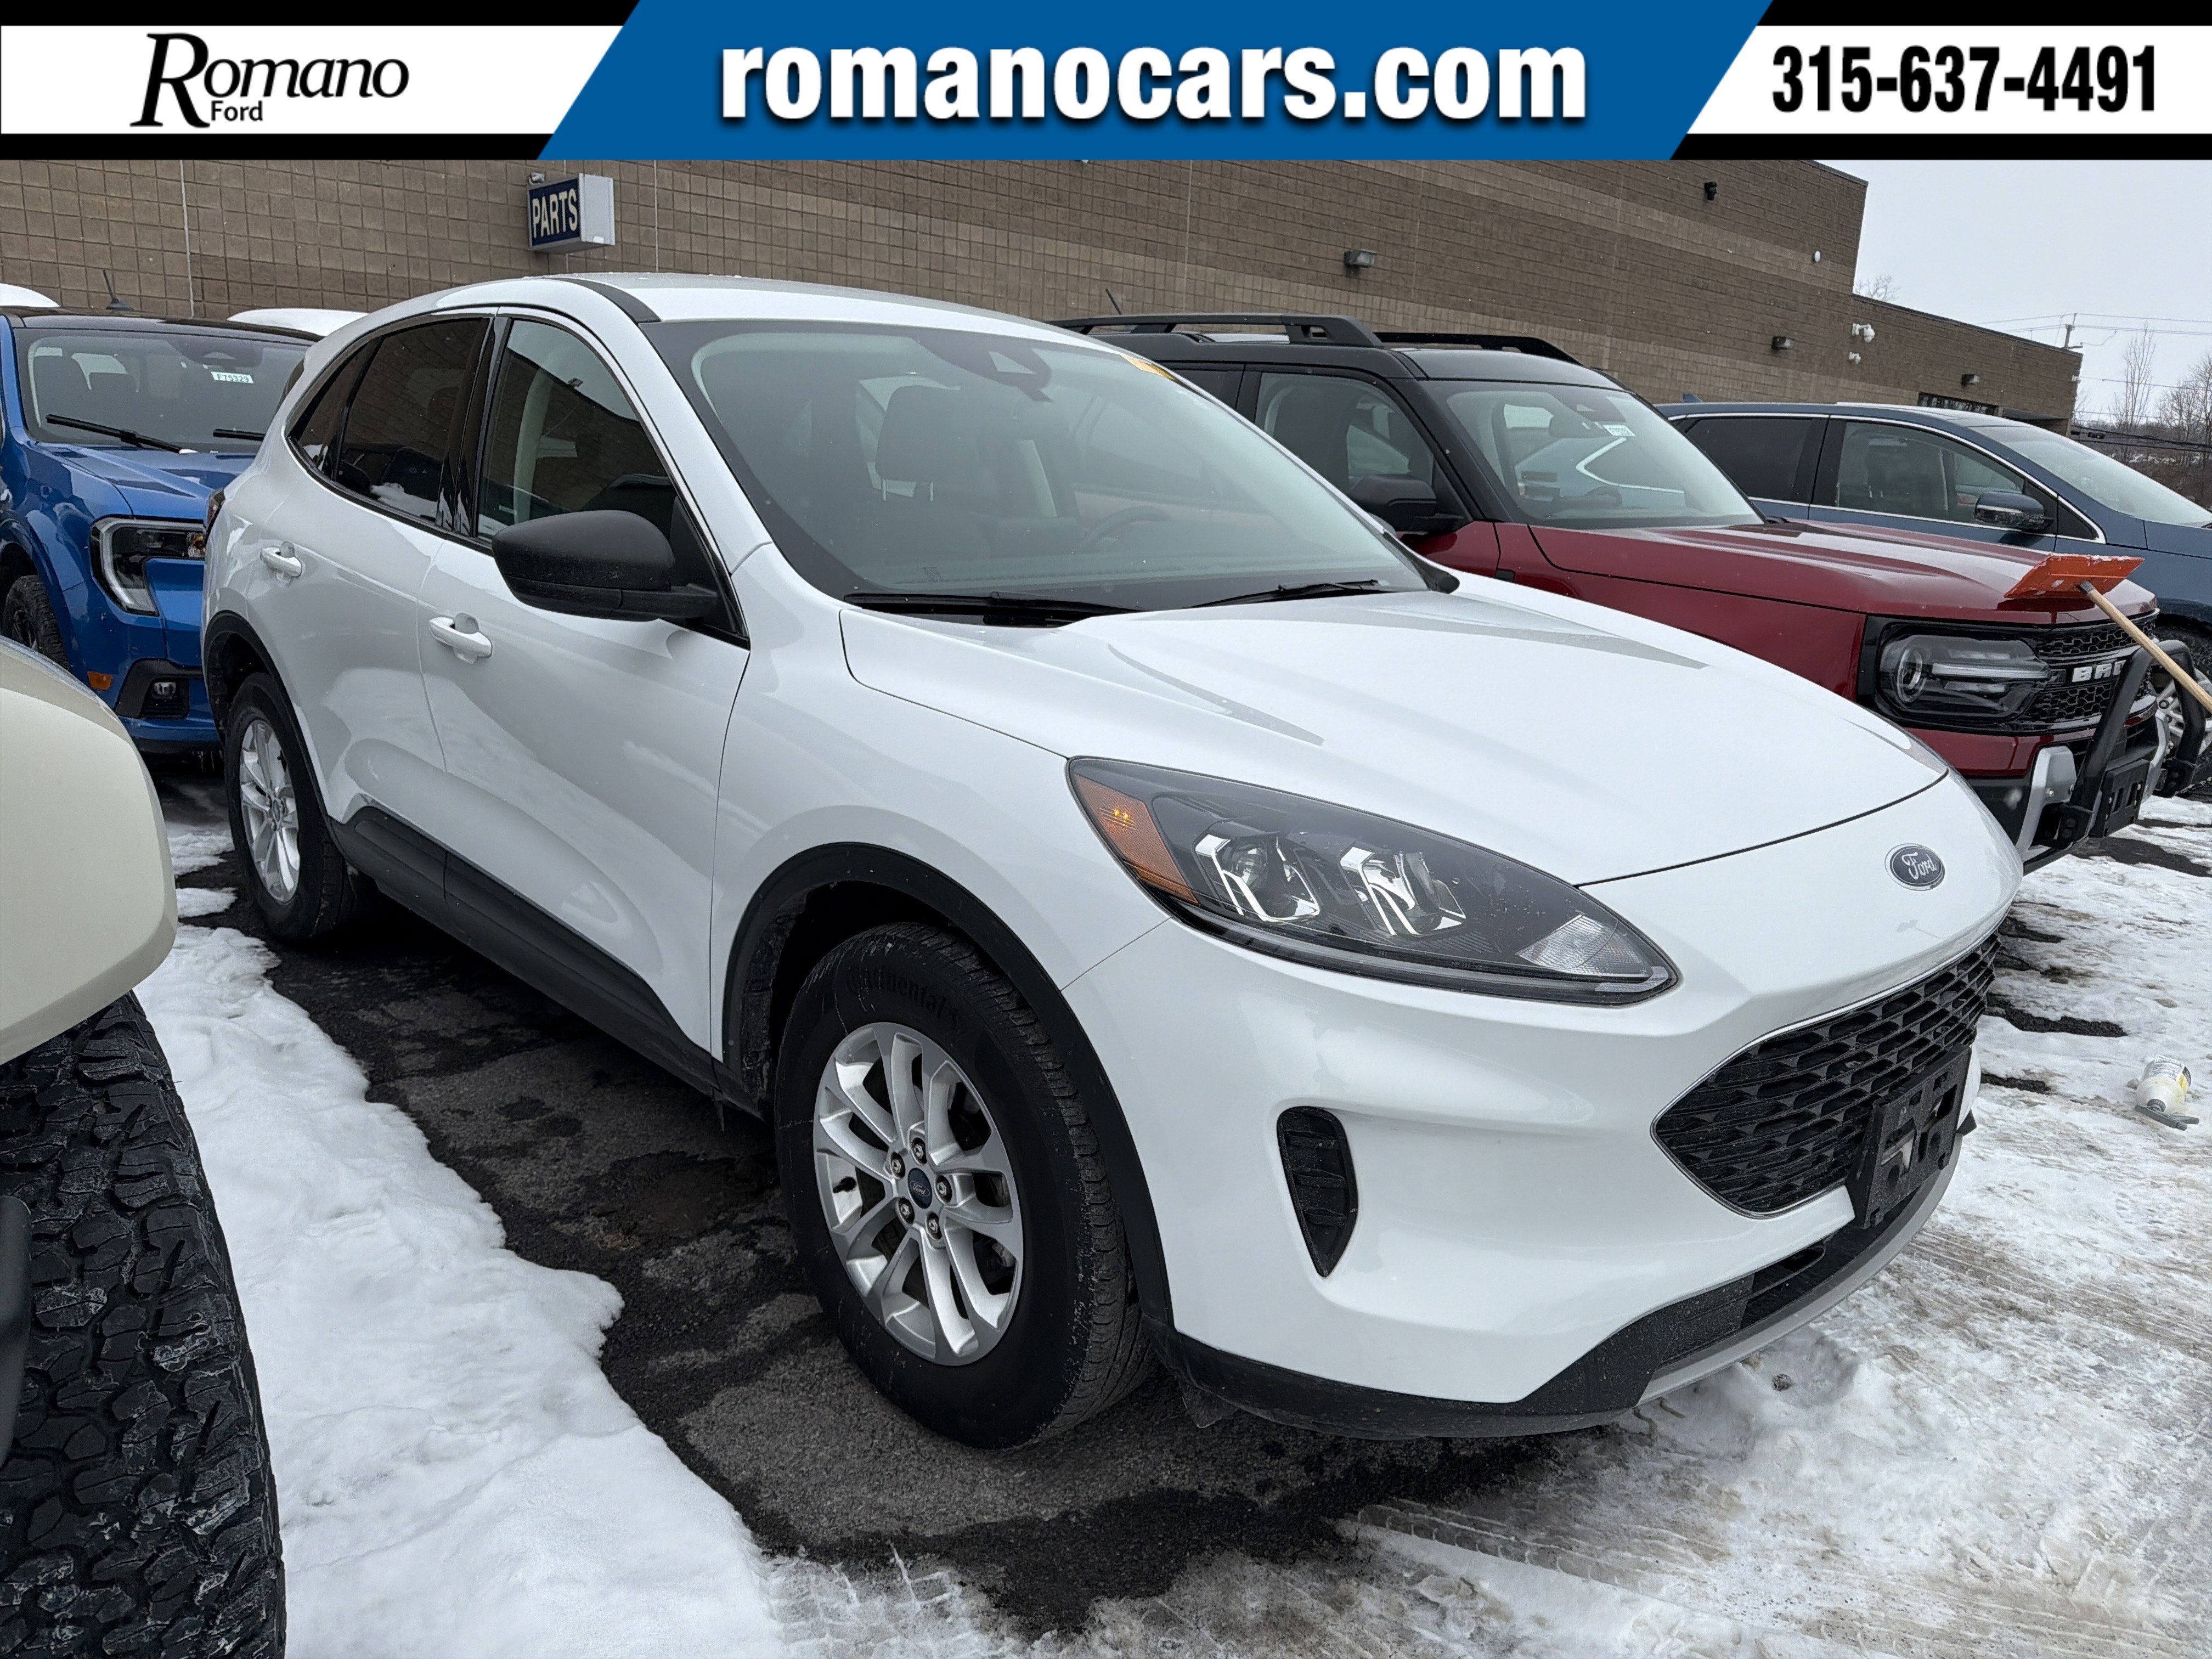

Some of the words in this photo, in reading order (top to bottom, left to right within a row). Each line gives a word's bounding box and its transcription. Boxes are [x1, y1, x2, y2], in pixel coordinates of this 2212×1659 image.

[532, 188, 578, 239] PARTS
[1901, 851, 1937, 880] Ford
[913, 1183, 926, 1195] Ford
